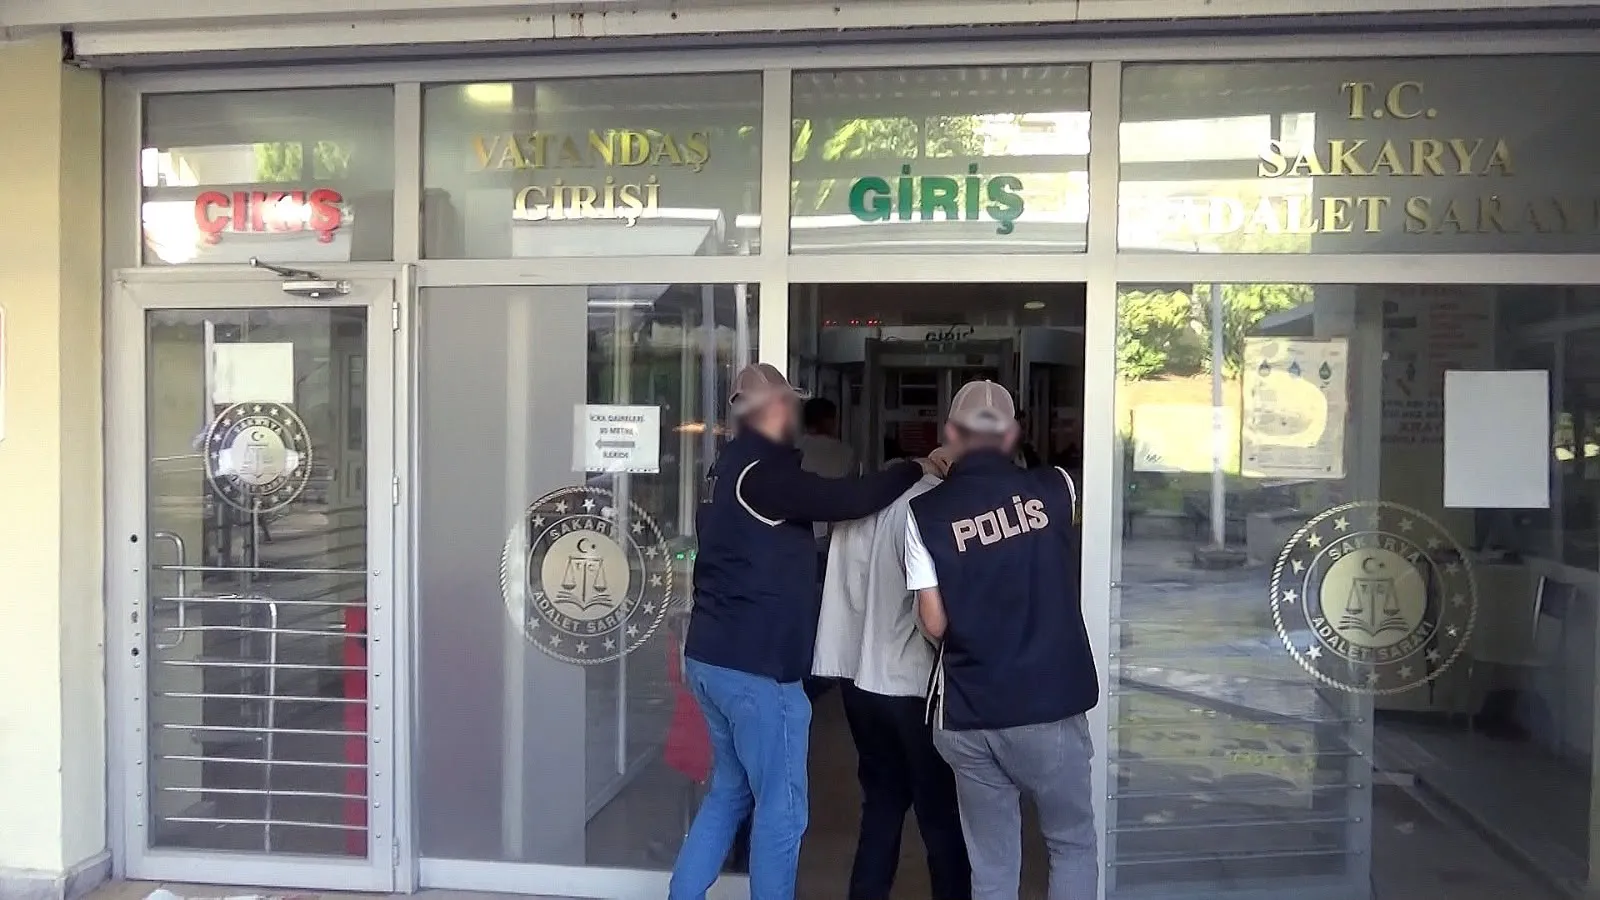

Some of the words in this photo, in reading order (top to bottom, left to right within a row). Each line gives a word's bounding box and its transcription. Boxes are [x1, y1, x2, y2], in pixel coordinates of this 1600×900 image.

[1338, 80, 1438, 120] T.C.
[471, 129, 711, 173] VATANDAŞ
[1257, 138, 1514, 178] SAKARYA
[194, 188, 344, 245] ÇIKIŞ
[514, 174, 661, 228] GİRİŞİ
[848, 163, 1025, 235] GİRİŞ
[549, 518, 618, 541] SAKAR
[951, 494, 1049, 552] POLİS
